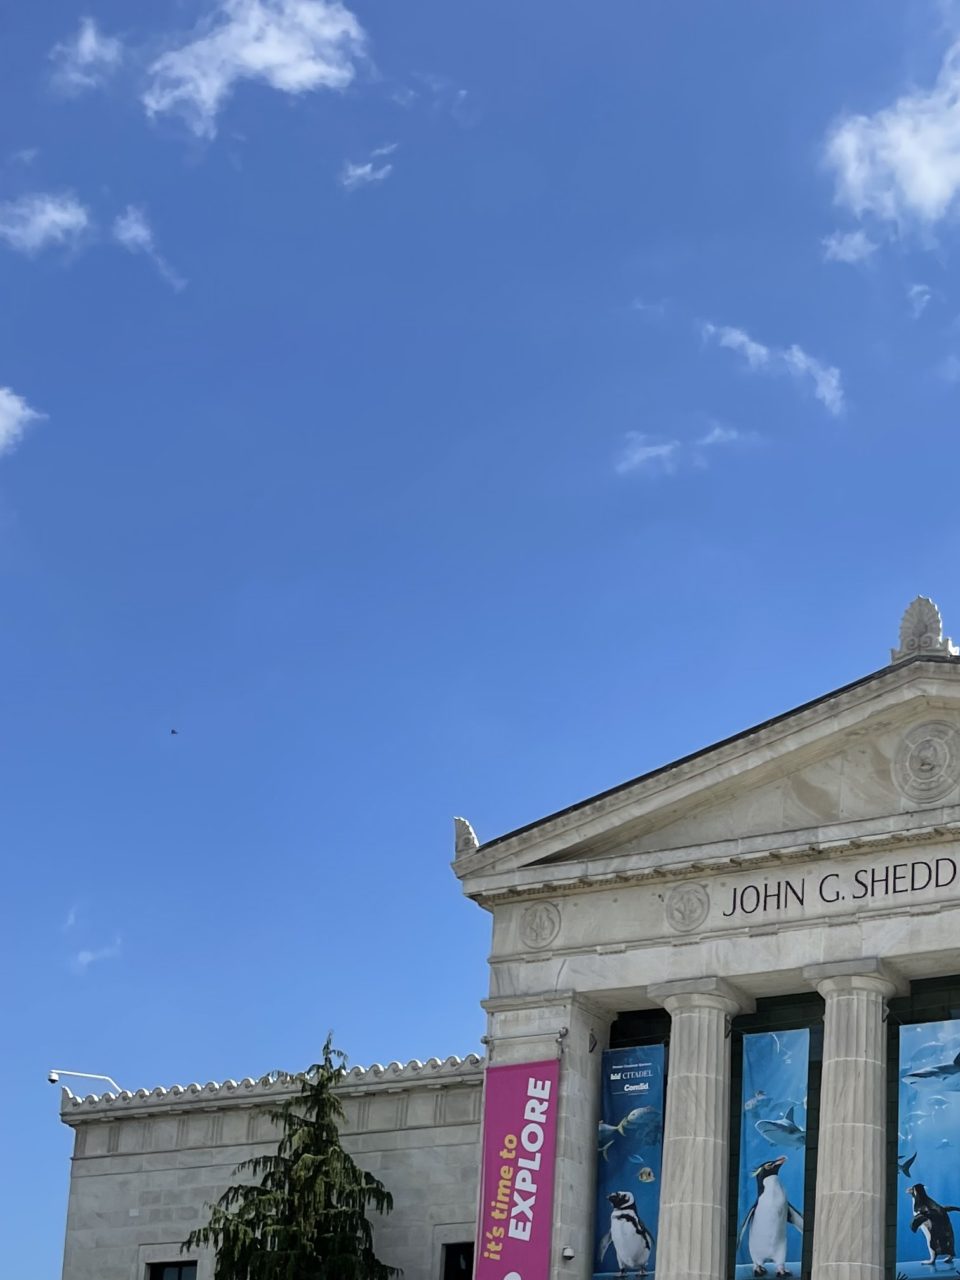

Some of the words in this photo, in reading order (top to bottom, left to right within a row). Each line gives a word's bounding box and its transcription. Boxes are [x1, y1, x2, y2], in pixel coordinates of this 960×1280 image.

[723, 877, 805, 918] JOHN
[818, 872, 846, 904] G.
[852, 857, 957, 899] SHEDD
[622, 1070, 654, 1080] CITADEL
[499, 1134, 518, 1160] to
[508, 1077, 551, 1242] EXPLORE
[491, 1163, 514, 1221] time
[483, 1224, 505, 1260] it's
